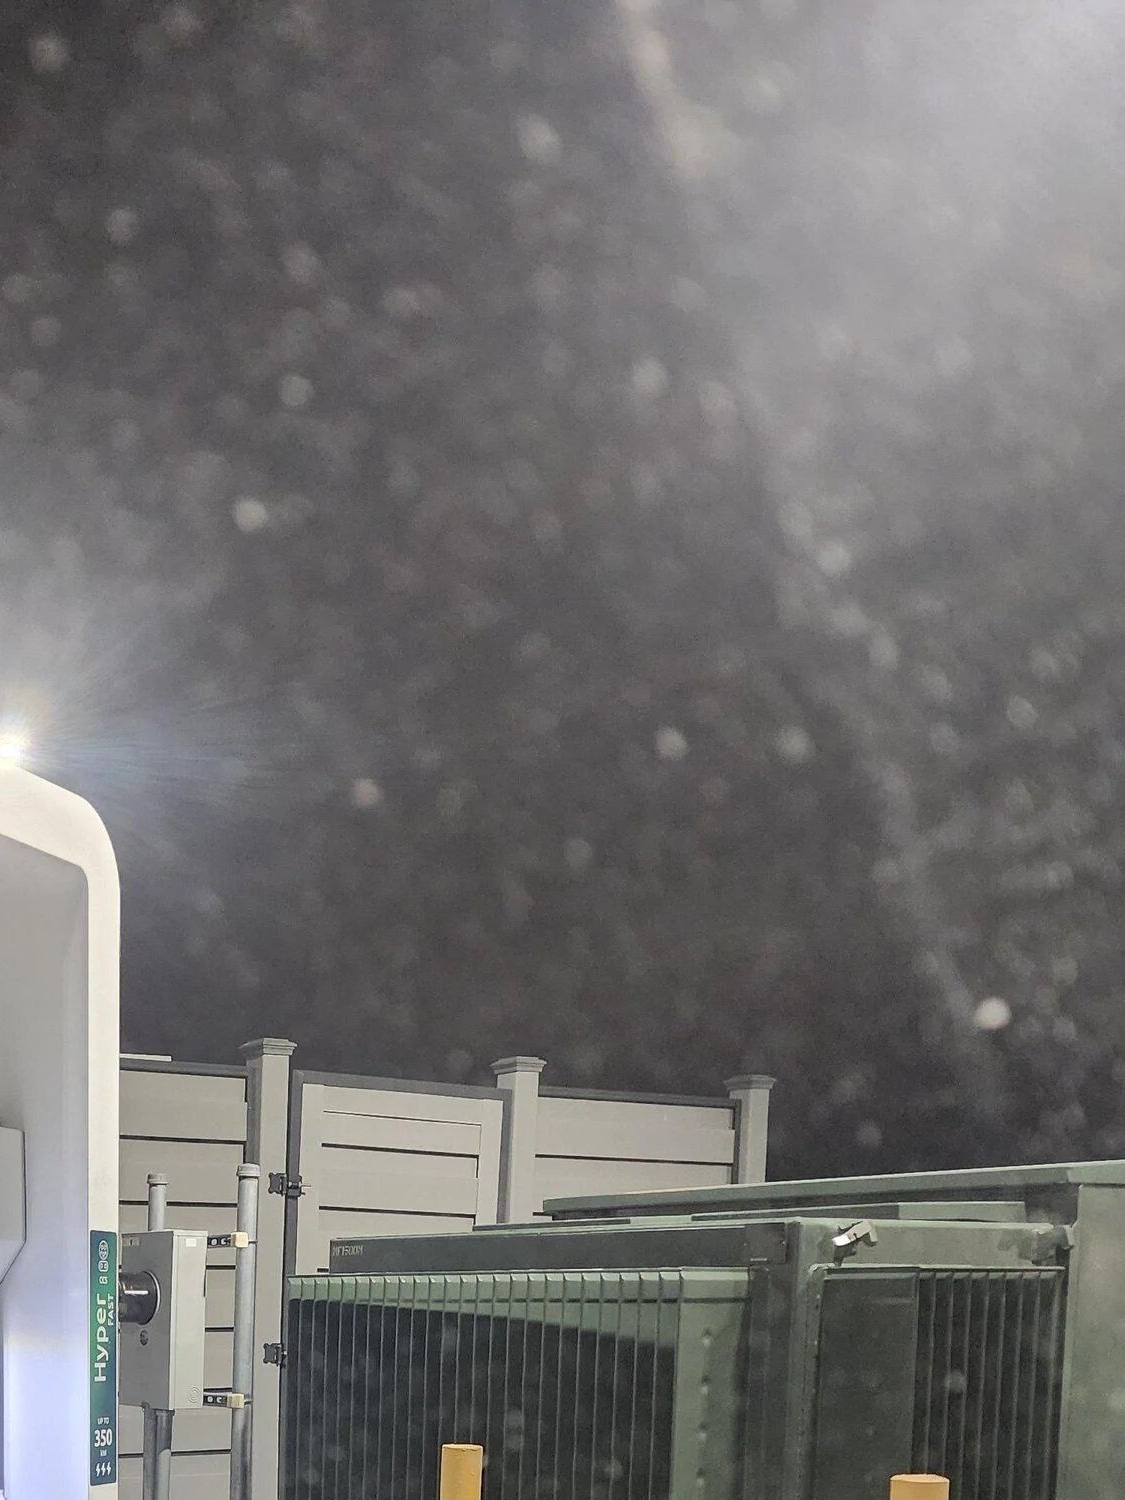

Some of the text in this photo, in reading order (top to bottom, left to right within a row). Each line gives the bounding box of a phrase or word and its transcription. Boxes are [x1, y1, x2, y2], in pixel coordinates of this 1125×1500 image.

[107, 1294, 115, 1326] FAST
[94, 1293, 109, 1382] Hyper
[94, 1428, 113, 1447] 350
